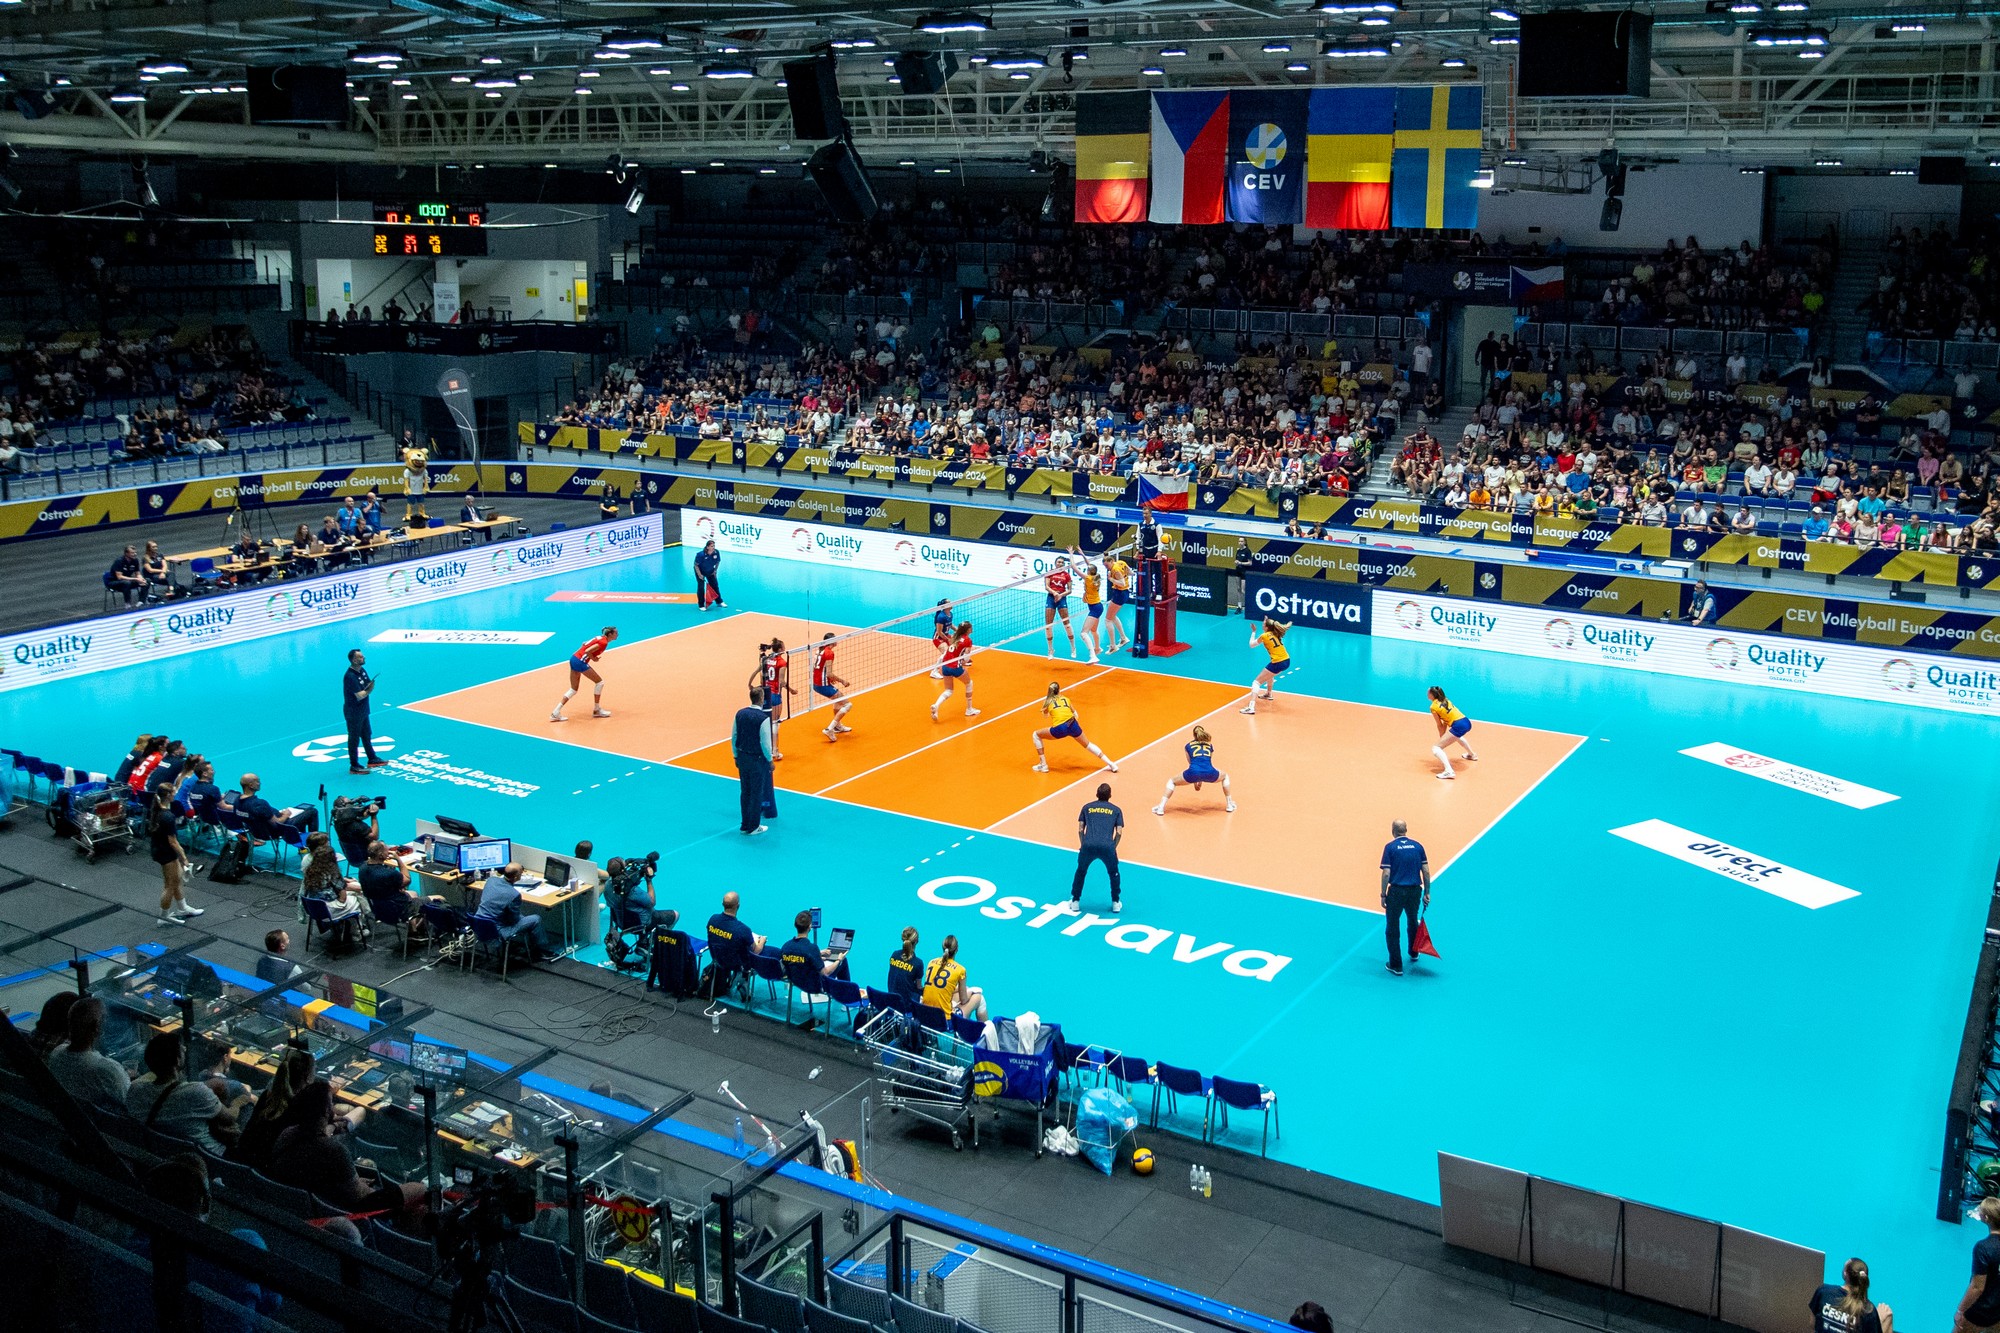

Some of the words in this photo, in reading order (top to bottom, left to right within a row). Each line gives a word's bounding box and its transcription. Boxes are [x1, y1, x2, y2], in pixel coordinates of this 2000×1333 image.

[1243, 173, 1286, 191] CEV
[386, 213, 398, 224] 10
[419, 204, 446, 217] 10:00
[469, 213, 480, 226] 15
[1359, 370, 1383, 381] 2024
[619, 437, 648, 450] Ostrava
[804, 455, 821, 466] CEV
[822, 457, 860, 472] Volleyball
[861, 461, 900, 476] European
[901, 464, 931, 477] Golden
[932, 468, 964, 481] League
[965, 469, 987, 482] 2024
[295, 477, 347, 493] European
[349, 475, 389, 487] Golden
[434, 473, 461, 485] 2024
[572, 475, 606, 488] Ostrava
[1088, 481, 1126, 495] Ostrava
[695, 487, 712, 499] CEV
[714, 489, 754, 505] Volleyball
[755, 494, 795, 509] European
[797, 498, 828, 513] Golden
[829, 503, 863, 518] League
[865, 506, 888, 519] 2024
[38, 506, 84, 522] Ostrava
[718, 520, 761, 541] Quality
[997, 521, 1036, 535] Ostrava
[1353, 507, 1378, 521] CEV
[1378, 509, 1433, 526] Volleyball
[1434, 515, 1488, 532] European
[1490, 520, 1533, 536] Golden
[1535, 525, 1580, 541] League
[1581, 528, 1612, 543] 2024
[608, 524, 650, 546] Quality
[730, 536, 754, 546] HOTEL
[816, 531, 862, 553] Quality
[619, 539, 642, 549] HOTEL
[517, 541, 564, 564] Quality
[828, 549, 854, 559] HOTEL
[920, 544, 970, 567] Quality
[1161, 538, 1178, 551] EV
[1179, 541, 1234, 560] Volleyball
[1251, 550, 1291, 567] ropean
[1293, 553, 1336, 570] Golden
[1338, 557, 1384, 576] League
[1386, 563, 1417, 579] 2024
[1757, 545, 1811, 562] Ostrava
[530, 557, 555, 568] HOTEL
[934, 561, 960, 573] HOTEL
[416, 560, 468, 585] Quality
[430, 577, 458, 588] HOTEL
[1180, 583, 1210, 594] European
[300, 581, 360, 608] Quality
[1197, 591, 1212, 600] 2024
[1566, 584, 1619, 601] Ostrava
[317, 599, 349, 612] HOTEL
[1255, 586, 1362, 623] Ostrava
[168, 606, 235, 635] Quality
[1430, 605, 1497, 632] Quality
[1785, 607, 1817, 624] CEV
[1821, 611, 1896, 632] Volleyball
[1900, 619, 1976, 642] European
[187, 624, 224, 639] HOTEL
[1447, 625, 1482, 637] HOTEL
[1583, 624, 1655, 652] Quality
[14, 634, 92, 665] Quality
[1601, 645, 1639, 658] HOTEL
[37, 654, 79, 670] HOTEL
[1747, 644, 1826, 672] Quality
[1767, 665, 1808, 679] HOTEL
[1948, 687, 1992, 701] HOTEL
[1949, 698, 1975, 707] OSTRAVA
[1976, 700, 1990, 708] CITY
[413, 749, 450, 760] CEV
[1190, 744, 1212, 758] 25
[397, 753, 474, 775] Volleyball
[465, 769, 541, 792] European
[432, 771, 491, 790] League
[1087, 806, 1114, 816] SWEDEN
[1688, 840, 1782, 878] direct
[1717, 865, 1760, 883] auto
[708, 924, 733, 940] SWEDEN
[917, 875, 1293, 982] Ostrava
[924, 965, 951, 989] 18
[1008, 1057, 1040, 1067] VOLLEYBALL
